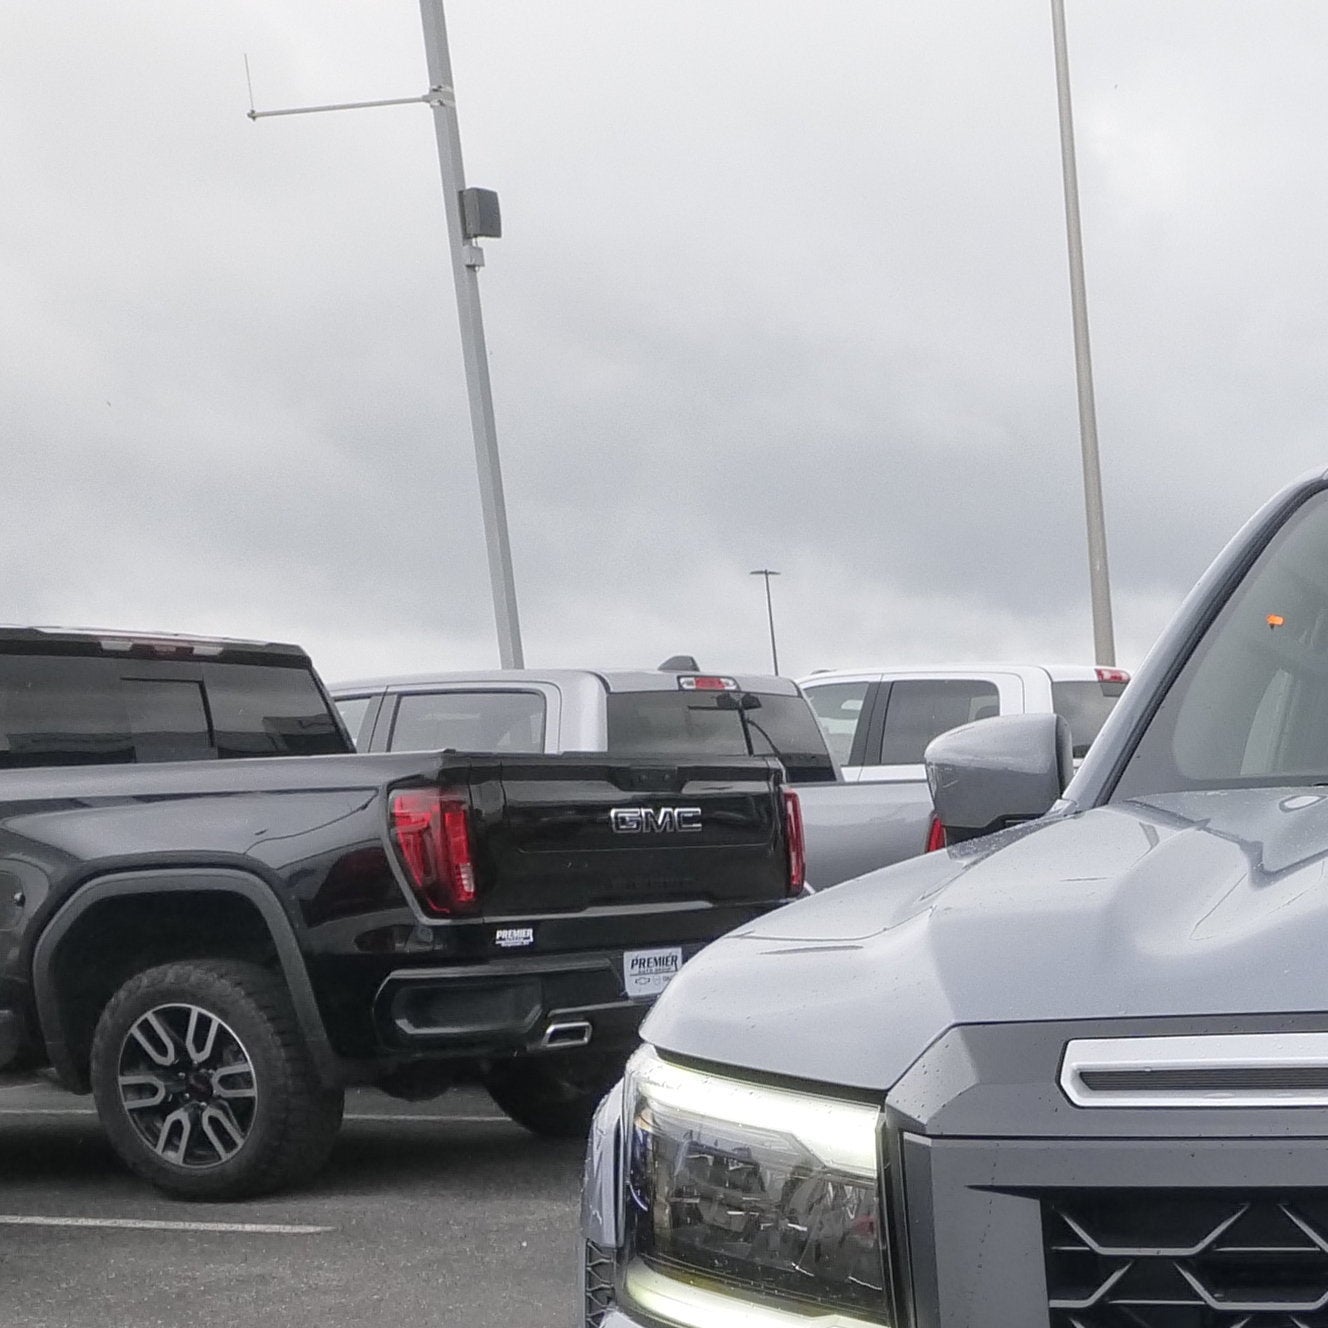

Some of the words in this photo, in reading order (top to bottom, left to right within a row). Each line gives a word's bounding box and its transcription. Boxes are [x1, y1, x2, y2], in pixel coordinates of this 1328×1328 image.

[610, 807, 702, 834] GMC
[495, 927, 534, 942] PREMIER
[630, 953, 678, 971] PREMIER
